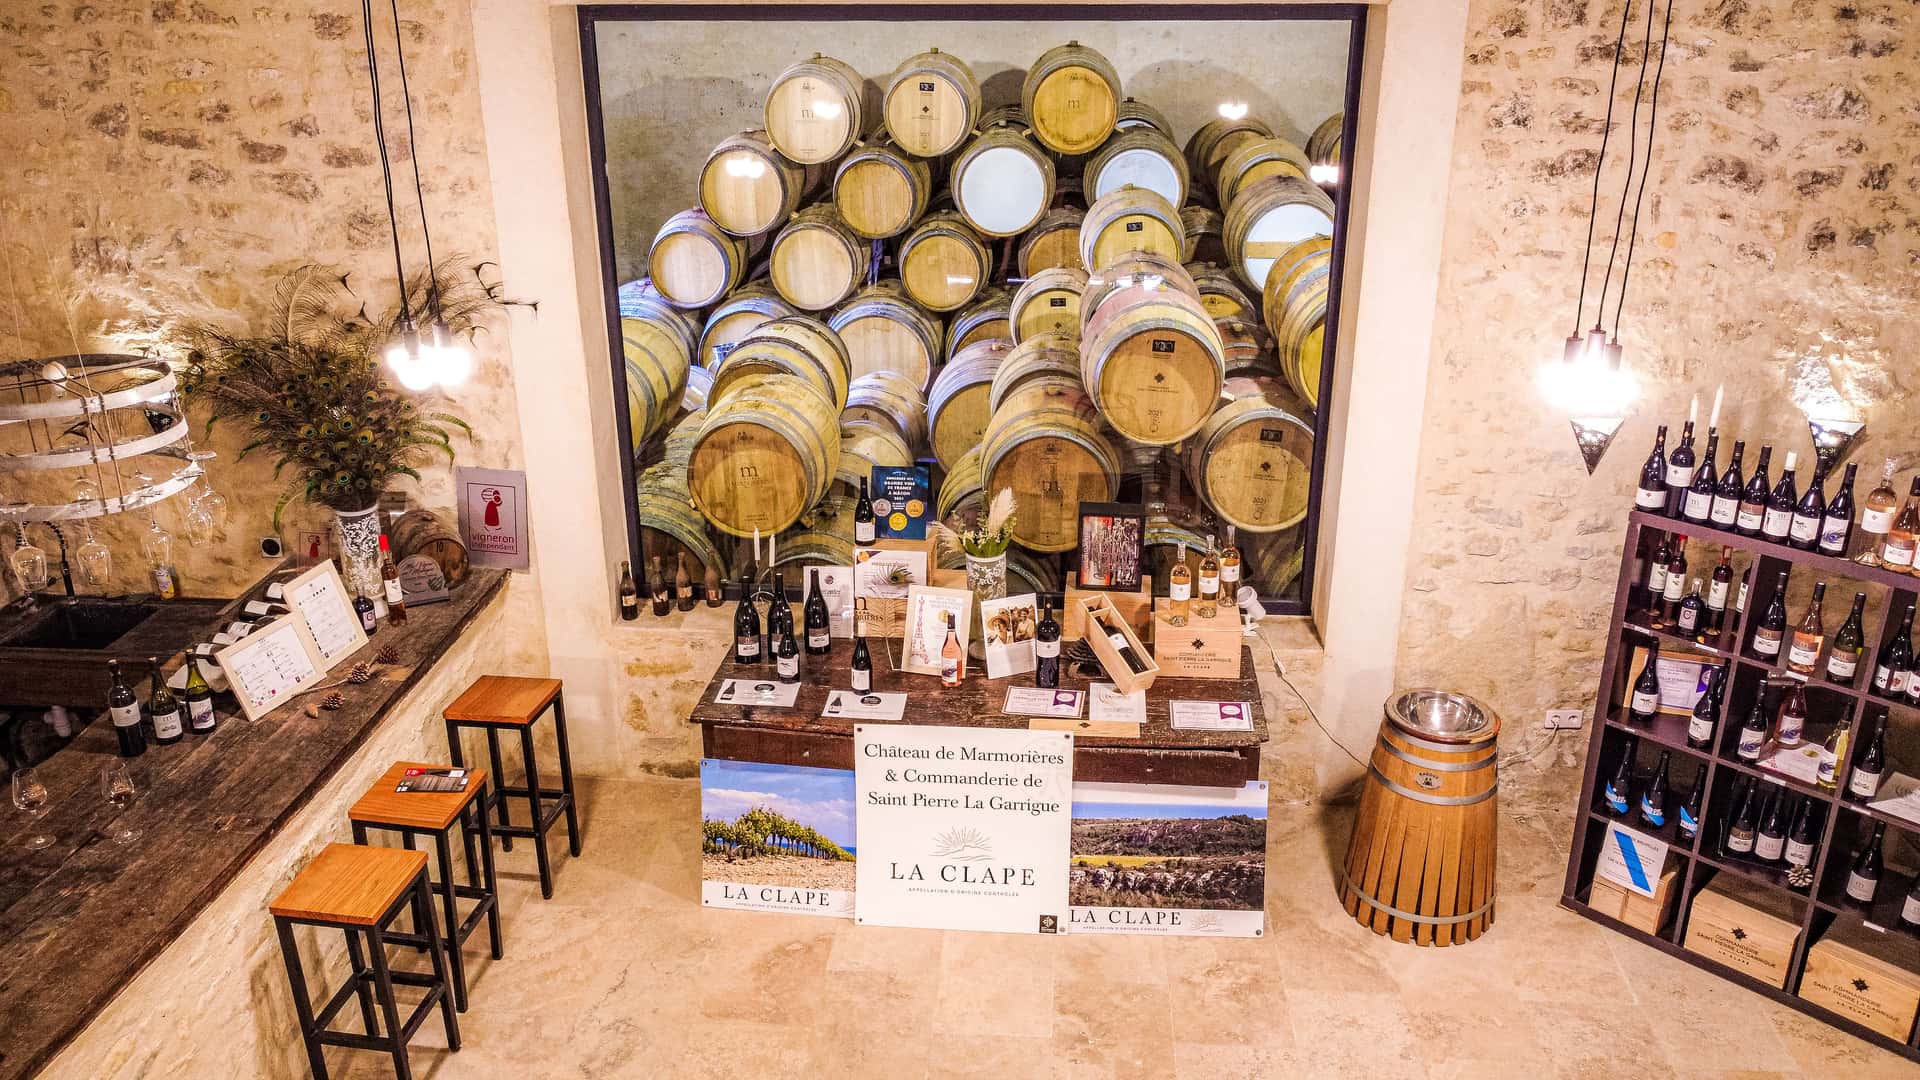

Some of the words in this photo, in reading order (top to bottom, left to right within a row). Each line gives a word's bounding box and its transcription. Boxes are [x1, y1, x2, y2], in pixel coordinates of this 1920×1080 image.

[436, 542, 444, 552] 10
[472, 533, 514, 545] vigneron
[864, 743, 930, 759] Château
[936, 746, 955, 760] de
[960, 747, 1064, 764] Marmorières
[885, 769, 898, 782] &
[904, 769, 1018, 786] Commanderie
[1023, 773, 1043, 787] de
[868, 792, 907, 806] Saint
[912, 793, 959, 808] Pierre
[965, 795, 984, 809] La
[989, 796, 1060, 815] Garrigue
[890, 862, 925, 881] LA
[940, 865, 1035, 886] CLAPE
[723, 885, 749, 900] LA
[760, 888, 830, 906] CLAPE
[1070, 909, 1096, 923] LA
[1108, 910, 1182, 926] CLAPE
[1697, 931, 1713, 942] SAINT
[1813, 981, 1831, 992] SAINT
